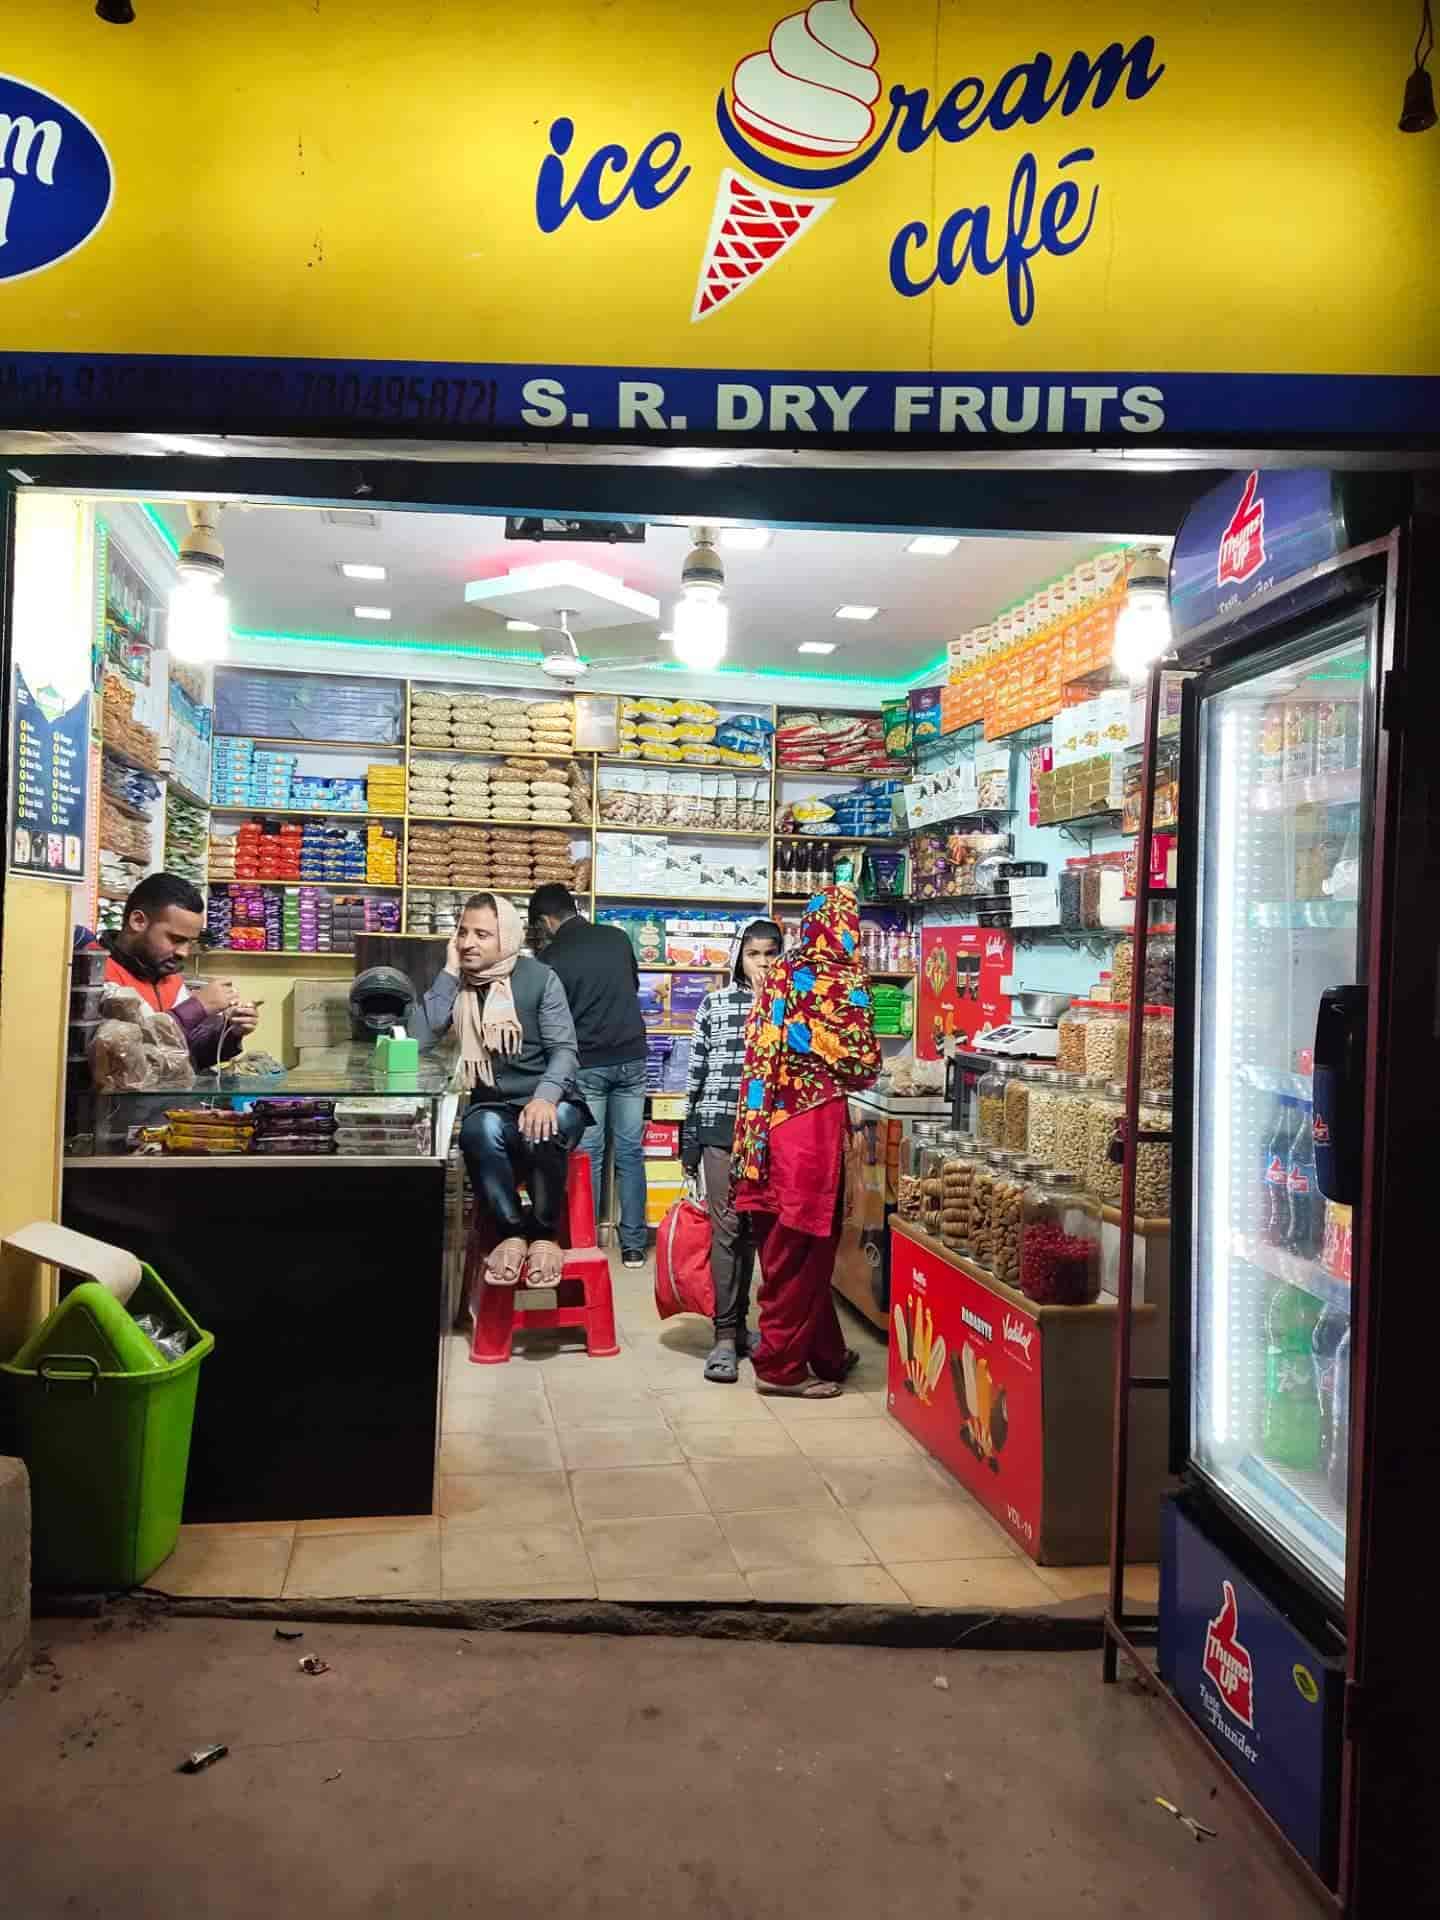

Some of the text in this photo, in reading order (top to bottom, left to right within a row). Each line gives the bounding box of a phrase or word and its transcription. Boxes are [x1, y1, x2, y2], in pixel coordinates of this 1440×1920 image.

[536, 116, 691, 233] ice
[889, 147, 1099, 326] café
[521, 378, 1165, 433] S. R. DRY FRUITS
[1208, 1635, 1250, 1684] Thums
[1208, 1707, 1259, 1764] Thunder
